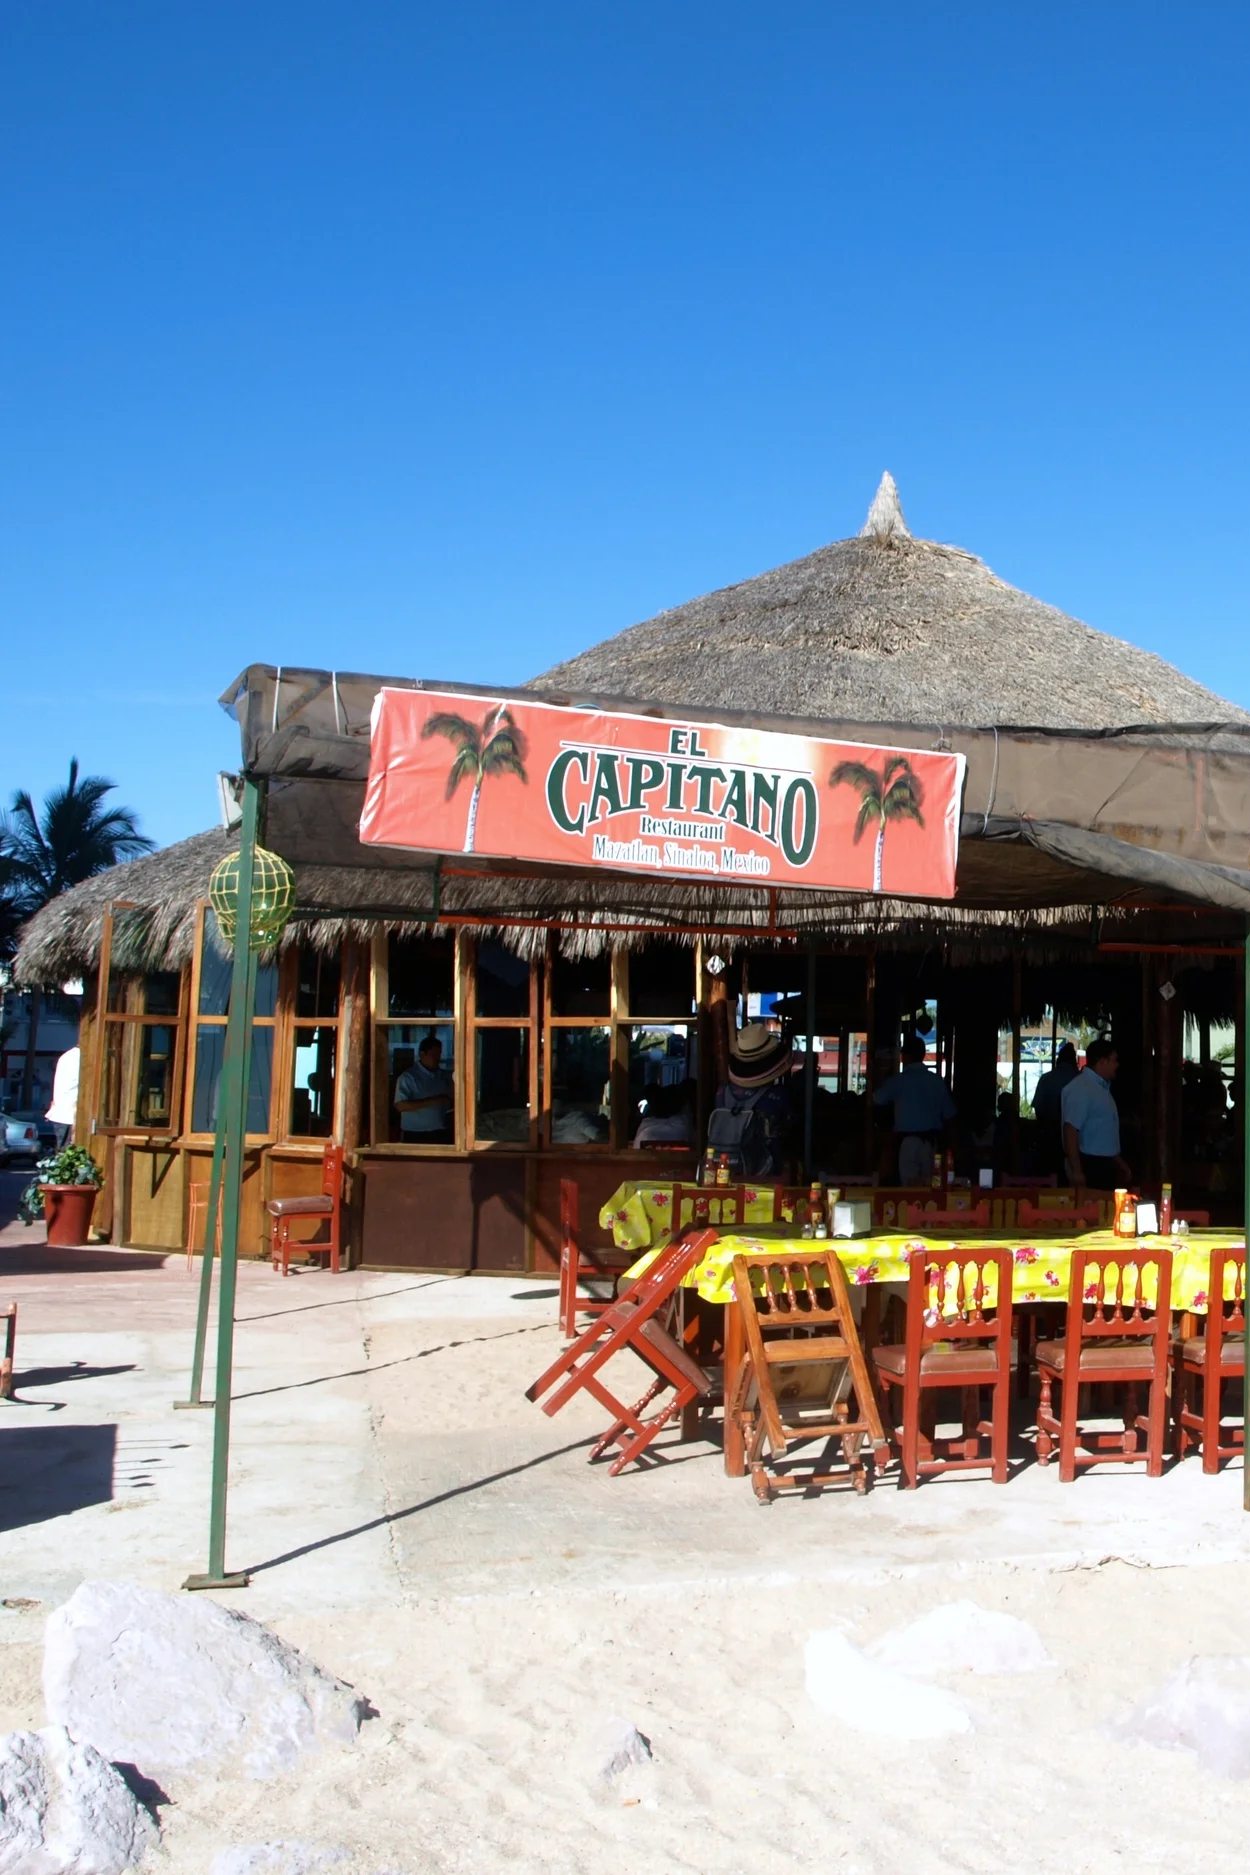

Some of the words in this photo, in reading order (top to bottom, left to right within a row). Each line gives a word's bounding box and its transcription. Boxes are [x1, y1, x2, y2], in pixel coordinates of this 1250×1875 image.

[671, 730, 706, 757] EL
[547, 750, 817, 866] CAPITANO
[640, 817, 725, 841] Restaurant
[593, 836, 662, 868] Mazatlan,
[664, 844, 719, 873] Sinaloa,
[721, 850, 770, 874] Mexico
